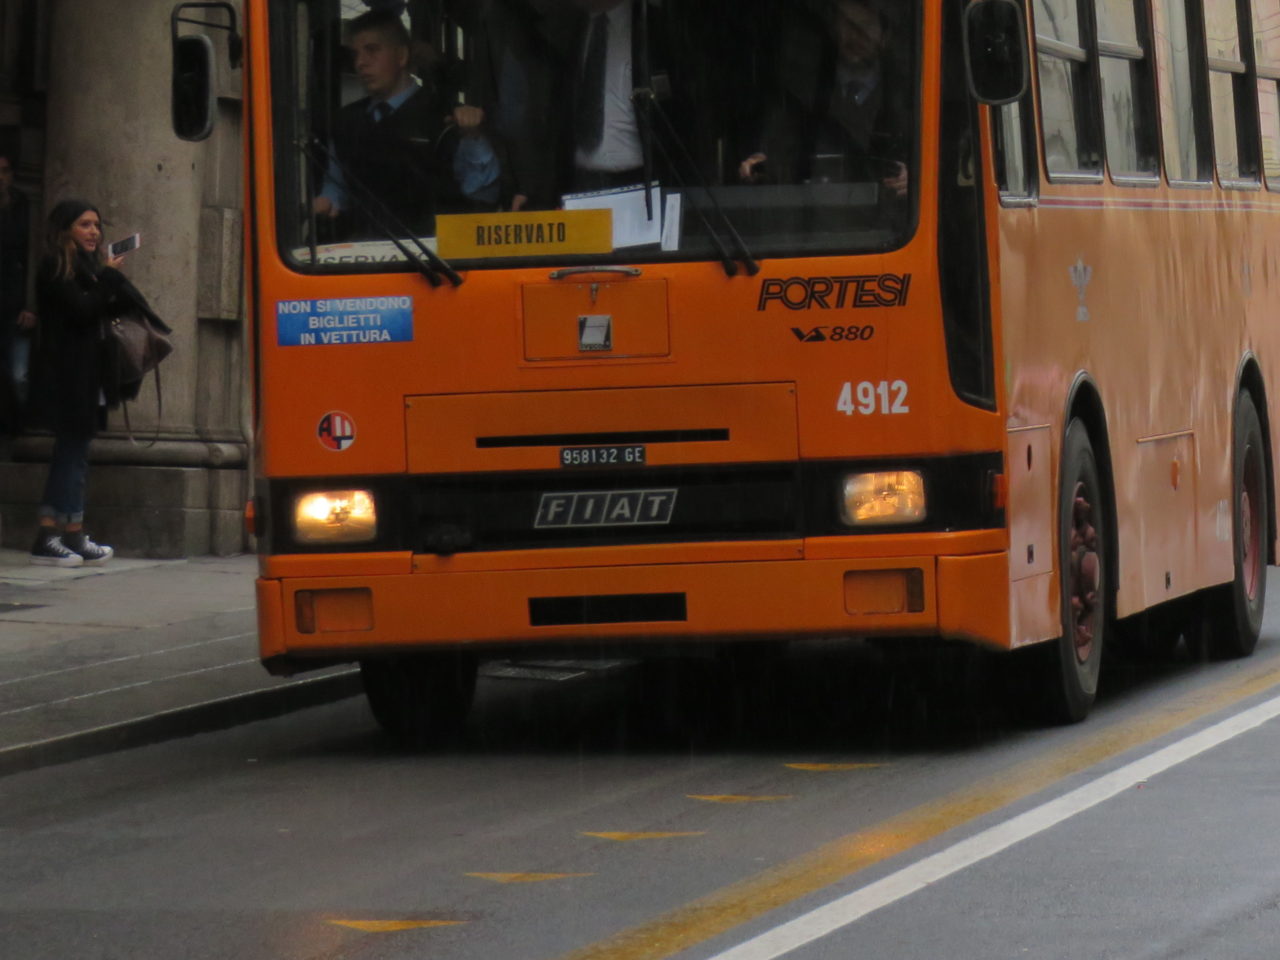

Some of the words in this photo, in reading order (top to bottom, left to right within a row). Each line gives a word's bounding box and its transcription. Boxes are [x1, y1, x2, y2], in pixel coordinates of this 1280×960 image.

[475, 221, 567, 246] RISERVATO
[757, 273, 912, 311] PORTESI
[277, 300, 311, 314] NON
[316, 299, 331, 313] SI
[336, 296, 412, 312] VENDONO
[308, 313, 381, 329] BIGLIETTI
[300, 331, 315, 345] IN
[320, 328, 392, 344] VETTURA
[836, 379, 910, 416] 4912
[563, 448, 618, 465] 958132
[624, 447, 643, 463] GE
[545, 494, 668, 523] FIAT
